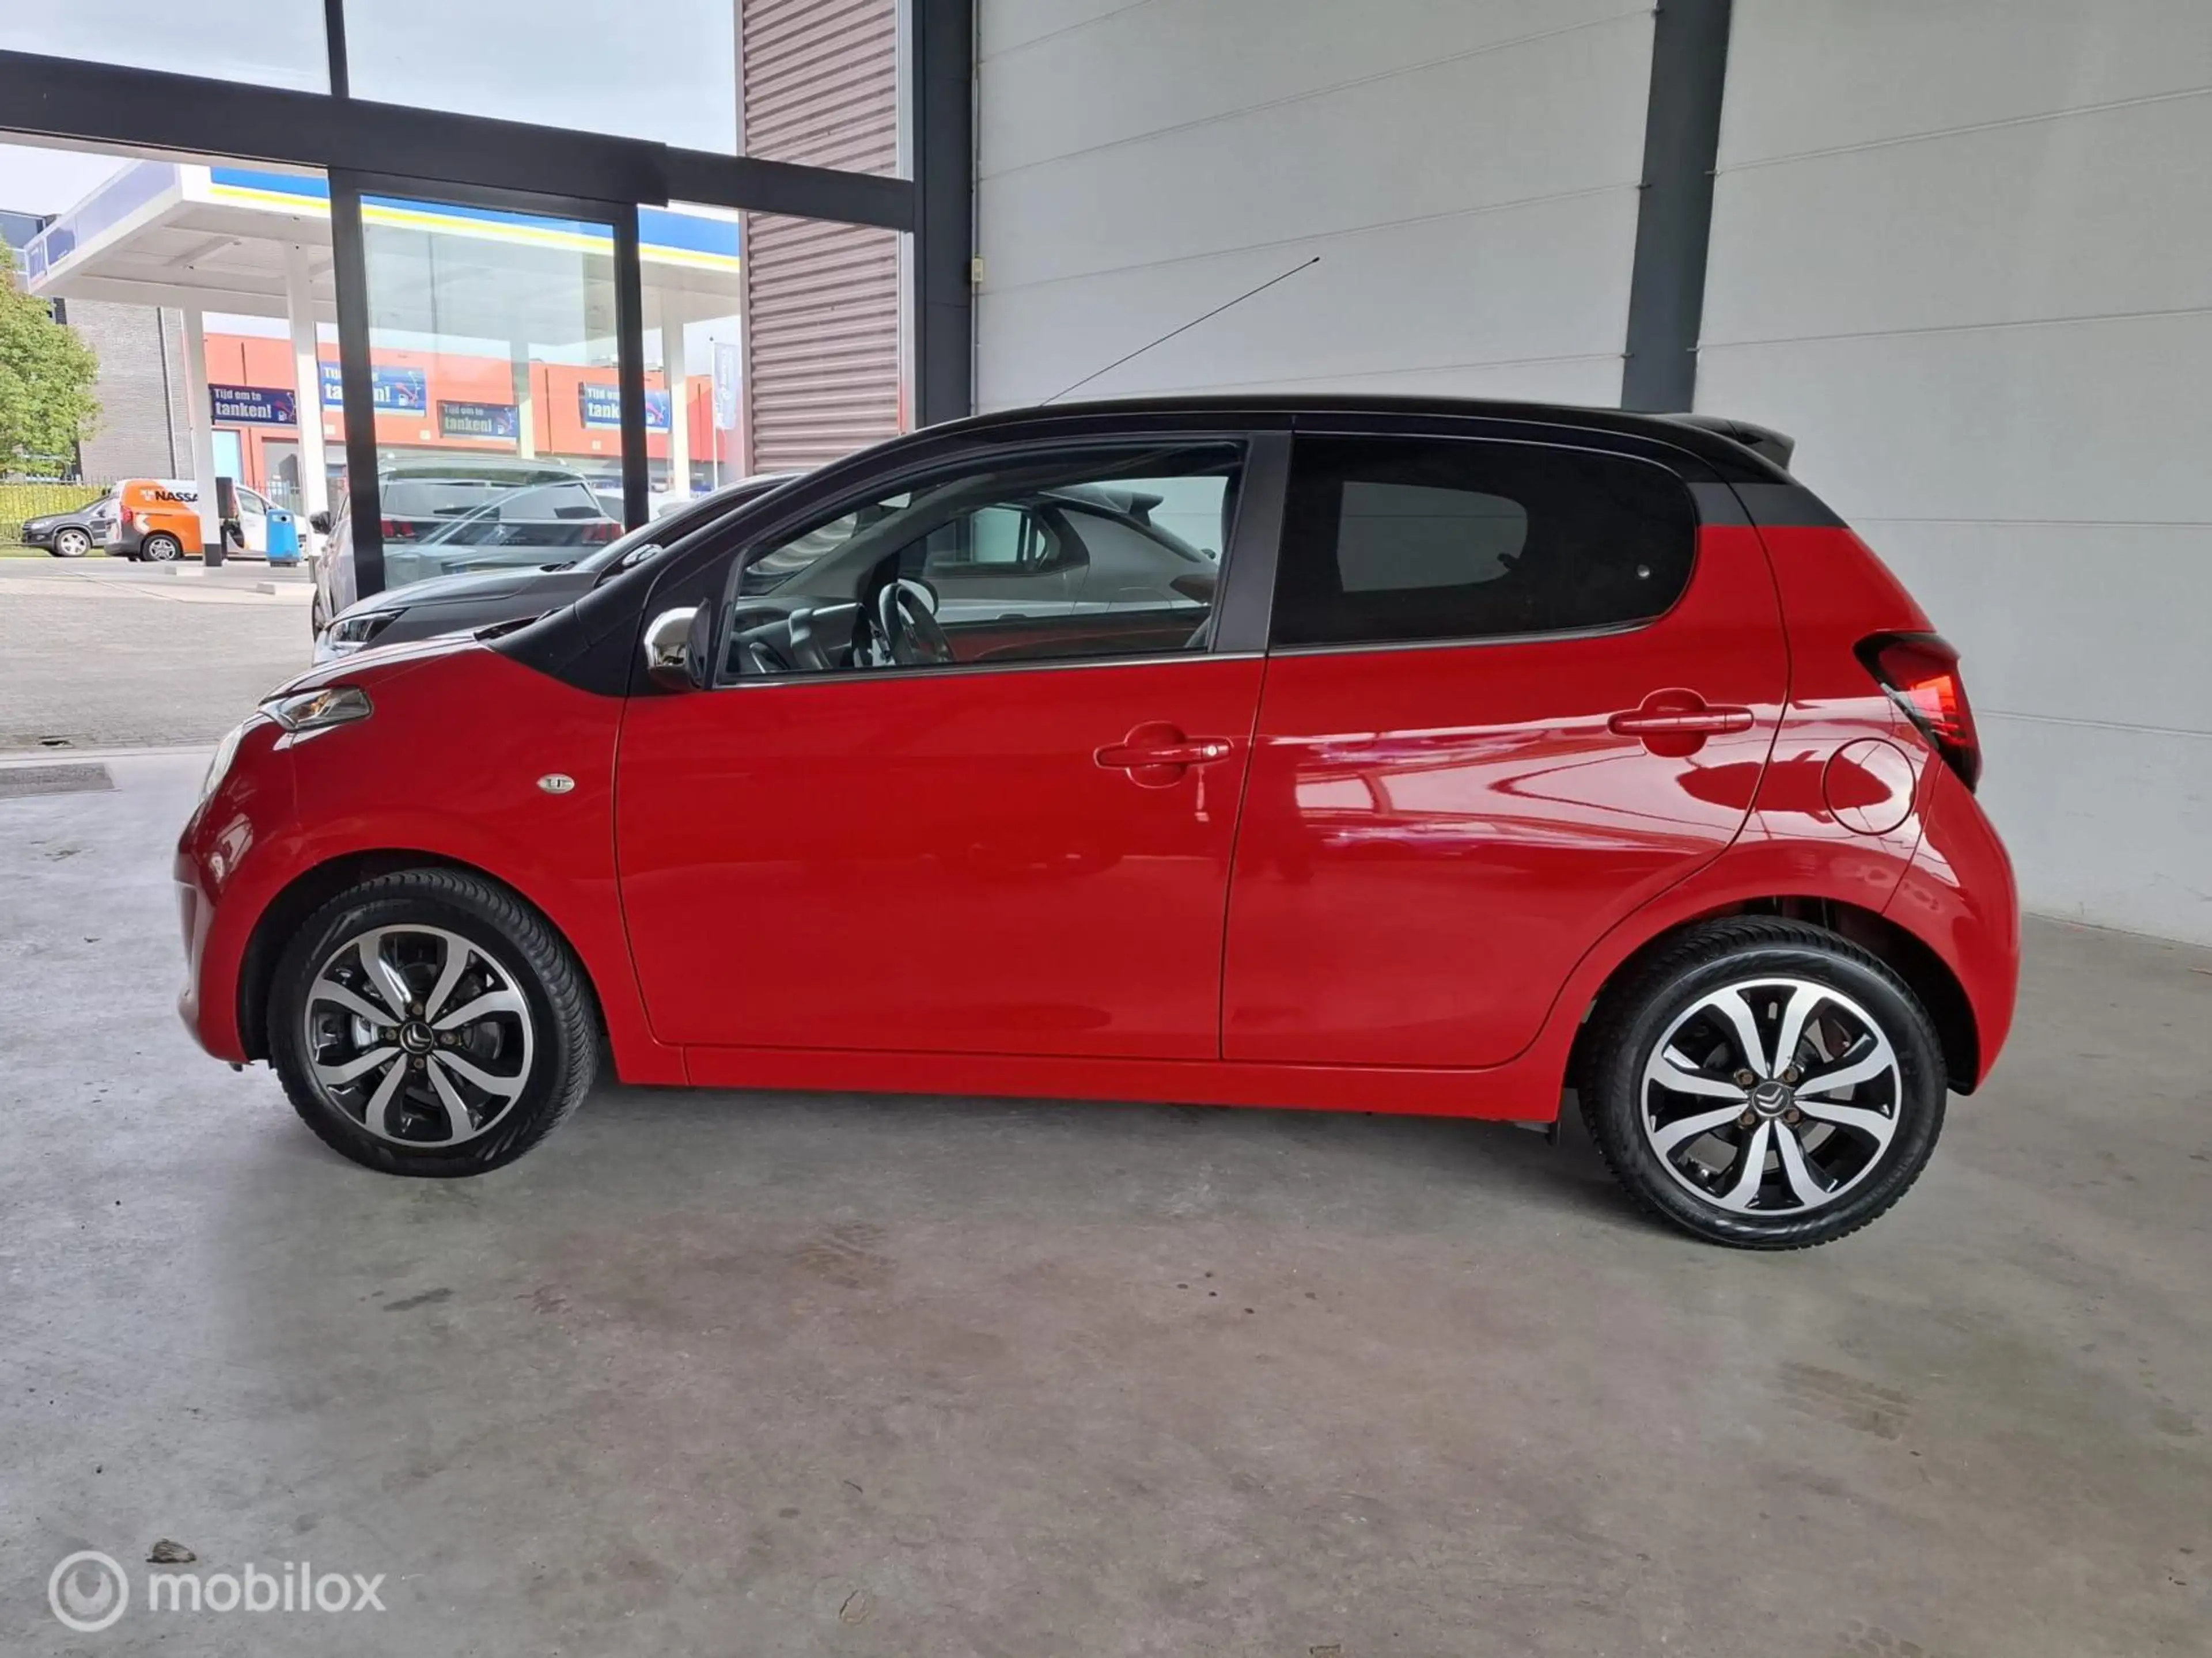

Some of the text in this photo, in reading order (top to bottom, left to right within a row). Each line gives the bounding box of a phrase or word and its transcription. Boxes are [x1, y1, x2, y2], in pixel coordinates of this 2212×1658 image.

[324, 367, 341, 380] Tij
[214, 389, 262, 401] Tijd om te
[215, 401, 272, 419] tanken!
[588, 402, 620, 419] tank
[445, 416, 493, 433] tanken!
[154, 491, 198, 502] NASSA
